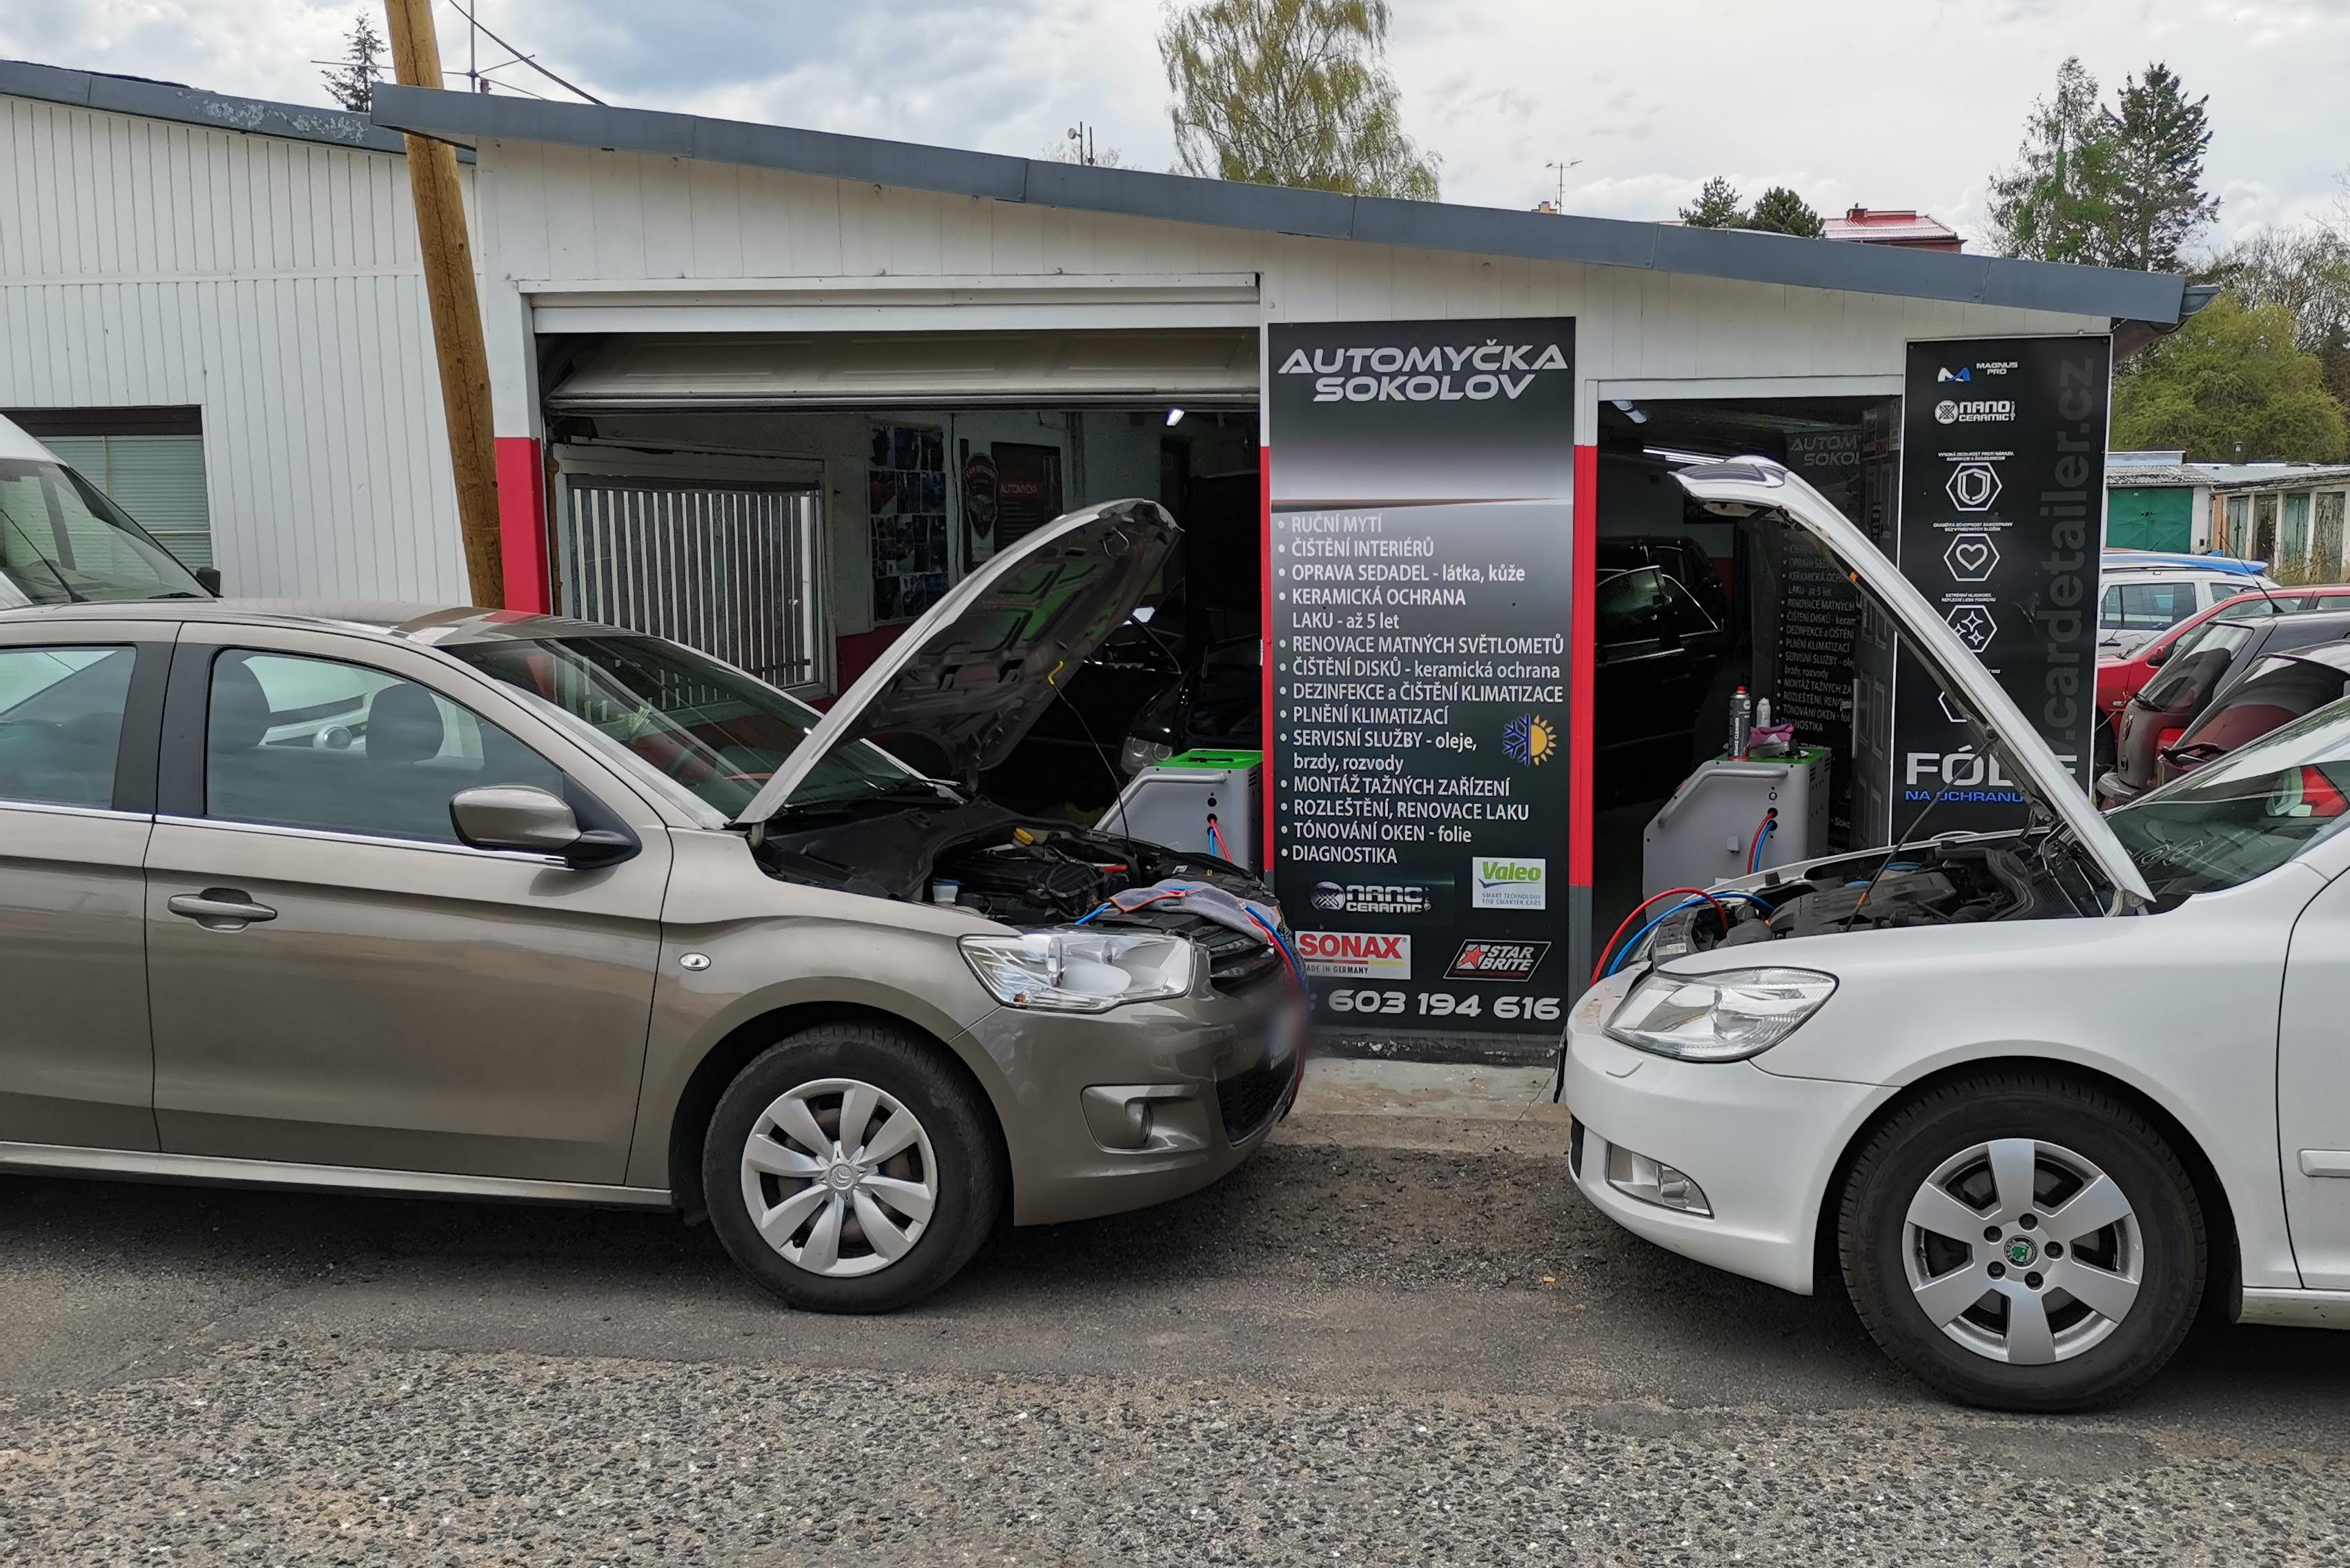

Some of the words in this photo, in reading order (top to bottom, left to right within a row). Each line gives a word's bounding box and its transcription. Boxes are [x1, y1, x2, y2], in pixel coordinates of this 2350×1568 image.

[1277, 338, 1569, 373] AUTOMYČKA
[1313, 373, 1536, 402] SOKOLOV
[1959, 400, 2010, 413] NANO
[1959, 413, 2010, 422] CERAMIC
[1789, 435, 1861, 451] AUTOM
[1292, 513, 1339, 532] RUČNÍ
[1344, 513, 1382, 532] MYTÍ
[1292, 537, 1351, 557] ČIŠTĚNÍ
[1354, 536, 1434, 557] INTERIÉRŮ
[1292, 565, 1355, 581] OPRAVA
[1358, 565, 1429, 582] SEDADEL
[1442, 564, 1485, 583] látka,
[1489, 564, 1525, 581] kůže
[1292, 585, 1382, 605] KERAMICKÁ
[1387, 589, 1467, 606] OCHRANA
[1292, 612, 1333, 629] LAKU
[1347, 613, 1363, 629] až
[1367, 614, 1375, 629] 5
[1380, 612, 1400, 629] let
[1292, 636, 1375, 654] RENOVACE
[1378, 634, 1455, 654] MATNÝCH
[1458, 634, 1565, 655] SVĚTLOMETŮ
[1293, 656, 1351, 677] ČIŠTĚNÍ
[1354, 657, 1402, 678] DISKŮ
[1414, 660, 1493, 679] keramická
[1497, 663, 1560, 679] ochrana
[1293, 683, 1384, 701] DEZINFEKCE
[1387, 689, 1397, 701] a
[1400, 680, 1458, 702] ČIŠTĚNÍ
[1461, 686, 1564, 703] KLIMATIZACE
[1293, 704, 1348, 724] PLNĚNÍ
[1351, 705, 1449, 725] KLIMATIZACÍ
[1293, 728, 1360, 747] SERVISNÍ
[1364, 728, 1422, 748] SLUŽBY
[1435, 733, 1476, 753] oleje,
[1293, 752, 1340, 774] brzdy,
[1343, 754, 1404, 774] rozvody
[1906, 744, 2077, 787] FÓL
[1293, 774, 1360, 794] MONTÁŽ
[1363, 775, 1434, 796] TAŽNÝCH
[1438, 777, 1511, 797] ZAŘÍZENÍ
[1905, 790, 1932, 801] NA
[1293, 797, 1393, 820] ROZLEŠTĚNÍ,
[1396, 801, 1482, 820] RENOVACE
[1486, 804, 1529, 821] LAKU
[1294, 821, 1378, 841] TÓNOVÁNÍ
[1381, 824, 1425, 842] OKEN
[1438, 827, 1472, 843] folie
[1292, 845, 1398, 865] DIAGNOSTIKA
[1482, 861, 1541, 881] Valeo
[1347, 885, 1423, 903] NANO
[1346, 902, 1423, 913] CERAMIC
[1298, 934, 1404, 960] SONAX
[1487, 945, 1535, 959] STAR
[1333, 966, 1369, 974] GERMANY
[1479, 958, 1535, 972] BRITE
[1328, 988, 1407, 1015] 603
[1417, 992, 1482, 1018] 194
[1493, 996, 1560, 1021] 616
